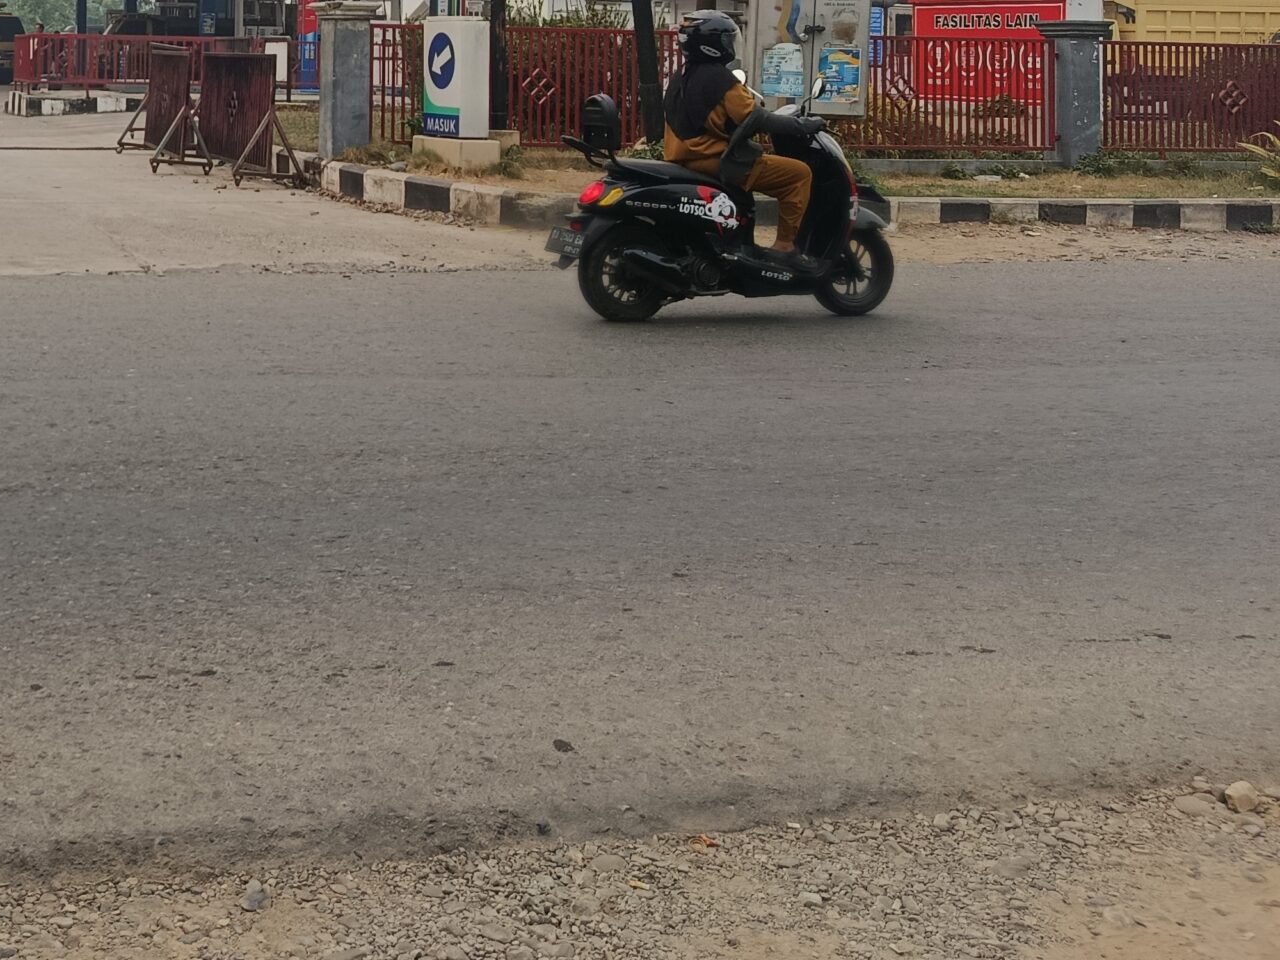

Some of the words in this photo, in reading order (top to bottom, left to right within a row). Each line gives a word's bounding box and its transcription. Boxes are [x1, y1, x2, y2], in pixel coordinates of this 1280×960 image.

[934, 15, 1001, 30] FASILITAS
[1006, 13, 1039, 28] LAIN
[426, 118, 456, 134] MASUK
[679, 203, 704, 216] LOTSO
